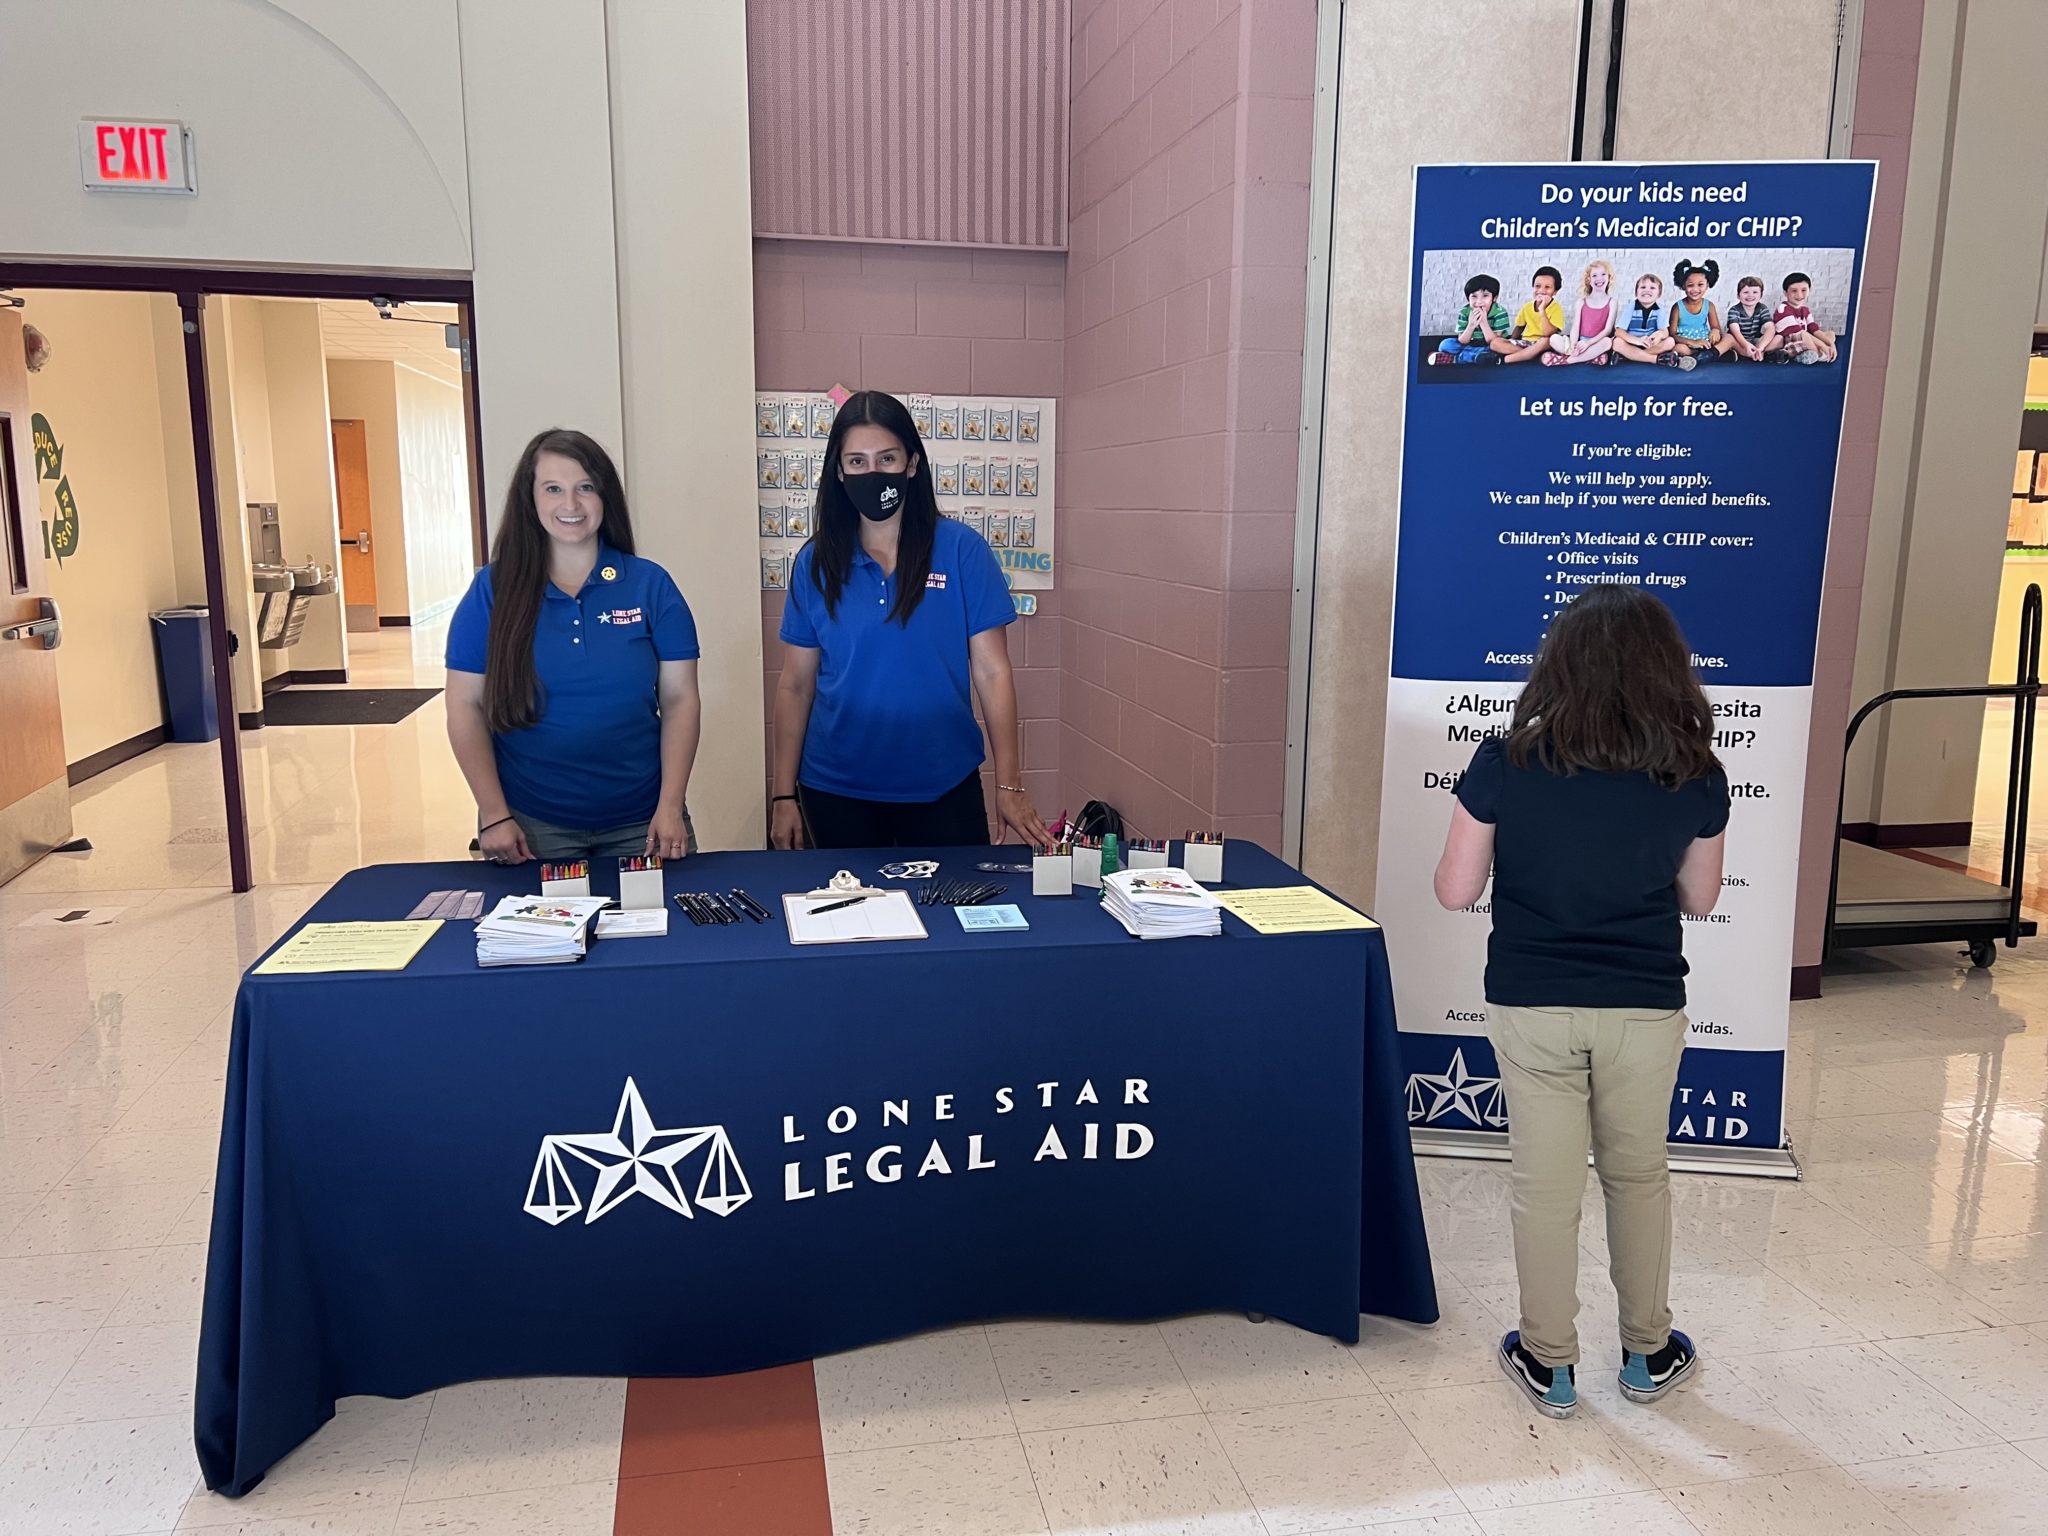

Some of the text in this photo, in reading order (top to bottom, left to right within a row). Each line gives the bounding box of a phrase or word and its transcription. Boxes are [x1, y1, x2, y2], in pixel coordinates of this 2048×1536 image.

[96, 126, 168, 181] EXIT
[1542, 182, 1746, 207] Do your kids need
[1597, 216, 1699, 237] Medicaid
[1706, 222, 1730, 237] or
[1737, 216, 1802, 236] CHIP?
[1521, 396, 1733, 420] Let us help for free.
[34, 431, 58, 468] DUCE
[1573, 444, 1586, 456] If
[1636, 444, 1691, 460] eligible:
[1549, 472, 1711, 488] We will help you apply.
[1489, 492, 1770, 508] We can help if you were denied benefits.
[56, 490, 73, 548] REUSE
[1575, 532, 1639, 545] Medicaid
[1645, 533, 1657, 545] &
[1663, 533, 1706, 545] CHIP
[1710, 537, 1753, 546] cover:
[1557, 552, 1638, 564] Office visits
[1646, 573, 1686, 588] drugs
[612, 607, 642, 617] LONE STAR
[613, 617, 631, 625] LEGAL
[1485, 652, 1533, 664] Access
[1690, 653, 1728, 667] lives.
[1711, 699, 1761, 717] esita
[1712, 730, 1755, 748] HIP?
[1445, 1009, 1486, 1022] Acces
[1691, 1022, 1733, 1035] vidas.
[1680, 1088, 1747, 1107] TAR
[783, 1078, 1151, 1143] LONE STAR
[1675, 1114, 1749, 1140] AID
[785, 1122, 1154, 1201] LEGAL AID
